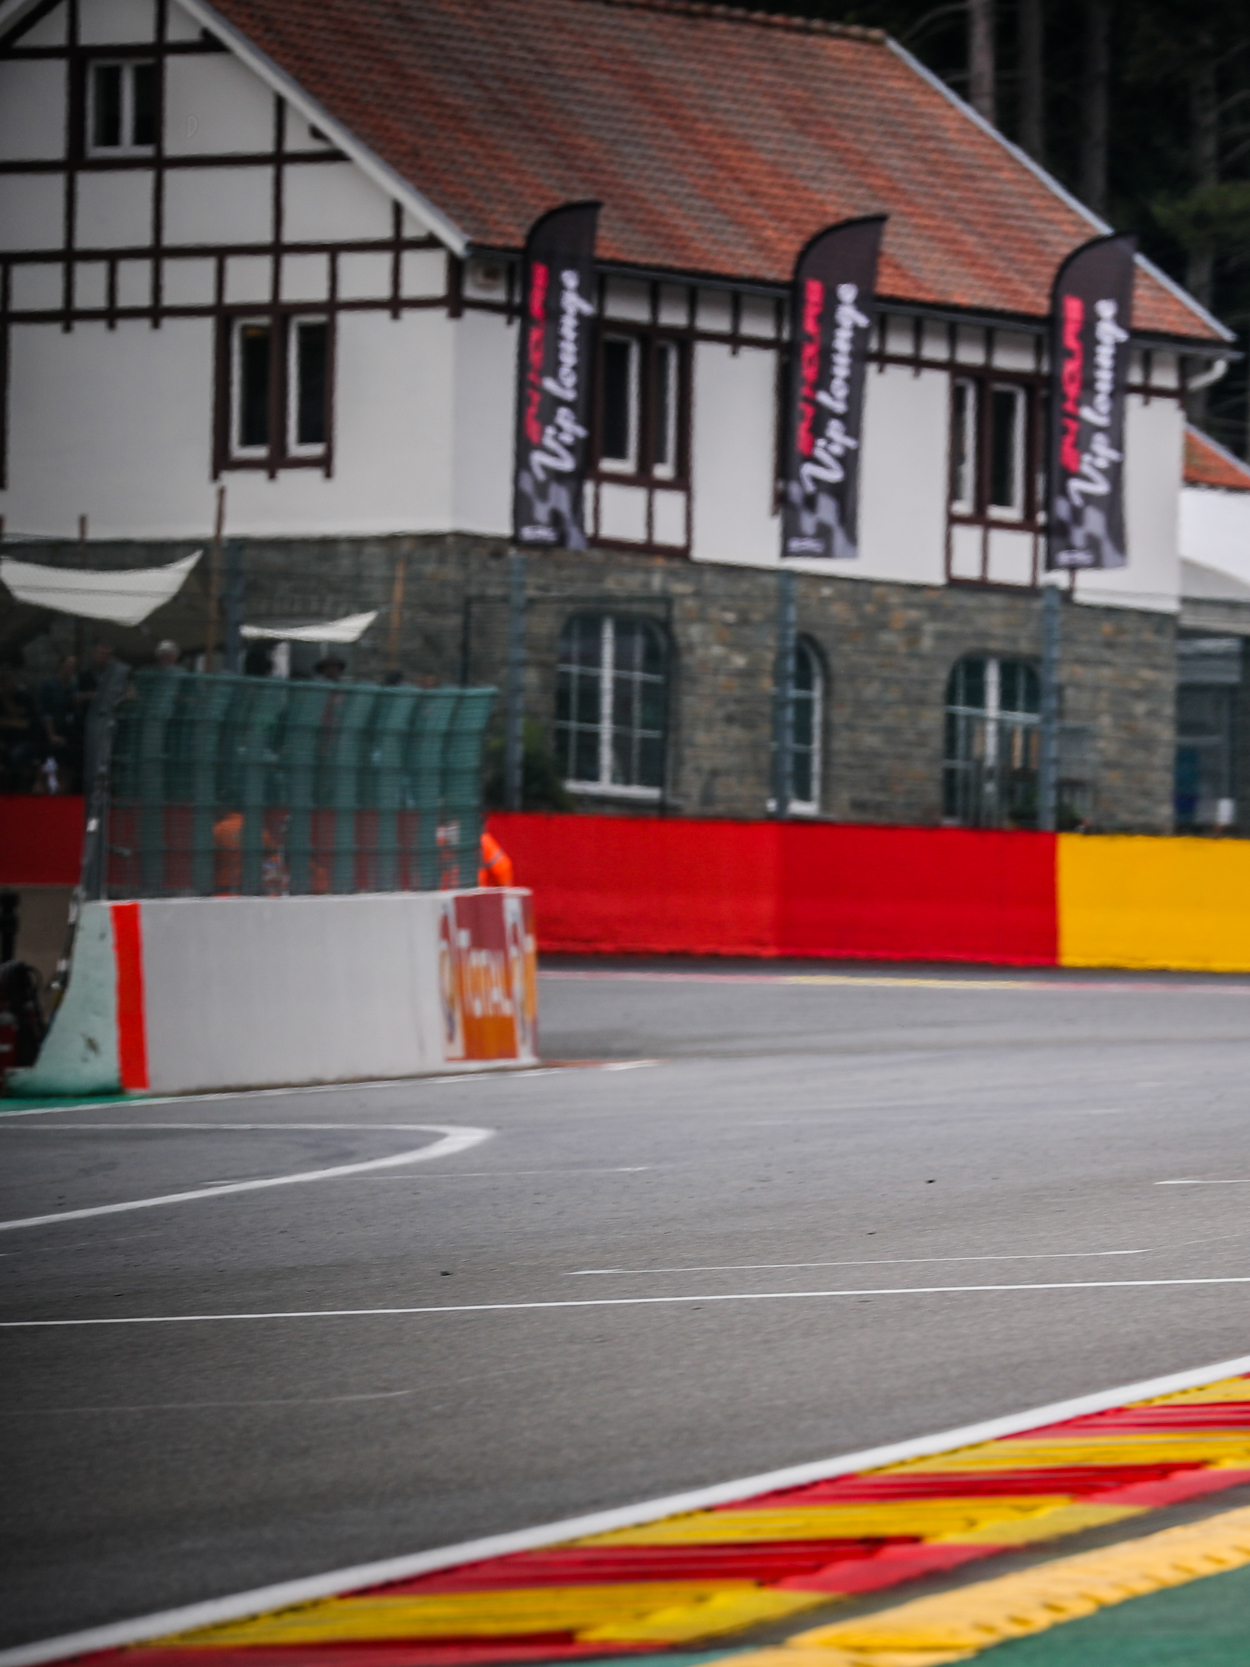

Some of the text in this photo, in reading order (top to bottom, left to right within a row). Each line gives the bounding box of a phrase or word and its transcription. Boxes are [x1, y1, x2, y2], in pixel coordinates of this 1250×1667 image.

[543, 270, 595, 401] lounge
[817, 283, 870, 414] lounge
[1079, 299, 1129, 427] lounge
[531, 407, 588, 480] Vip
[801, 418, 858, 492] Vip
[1068, 432, 1121, 506] Vip
